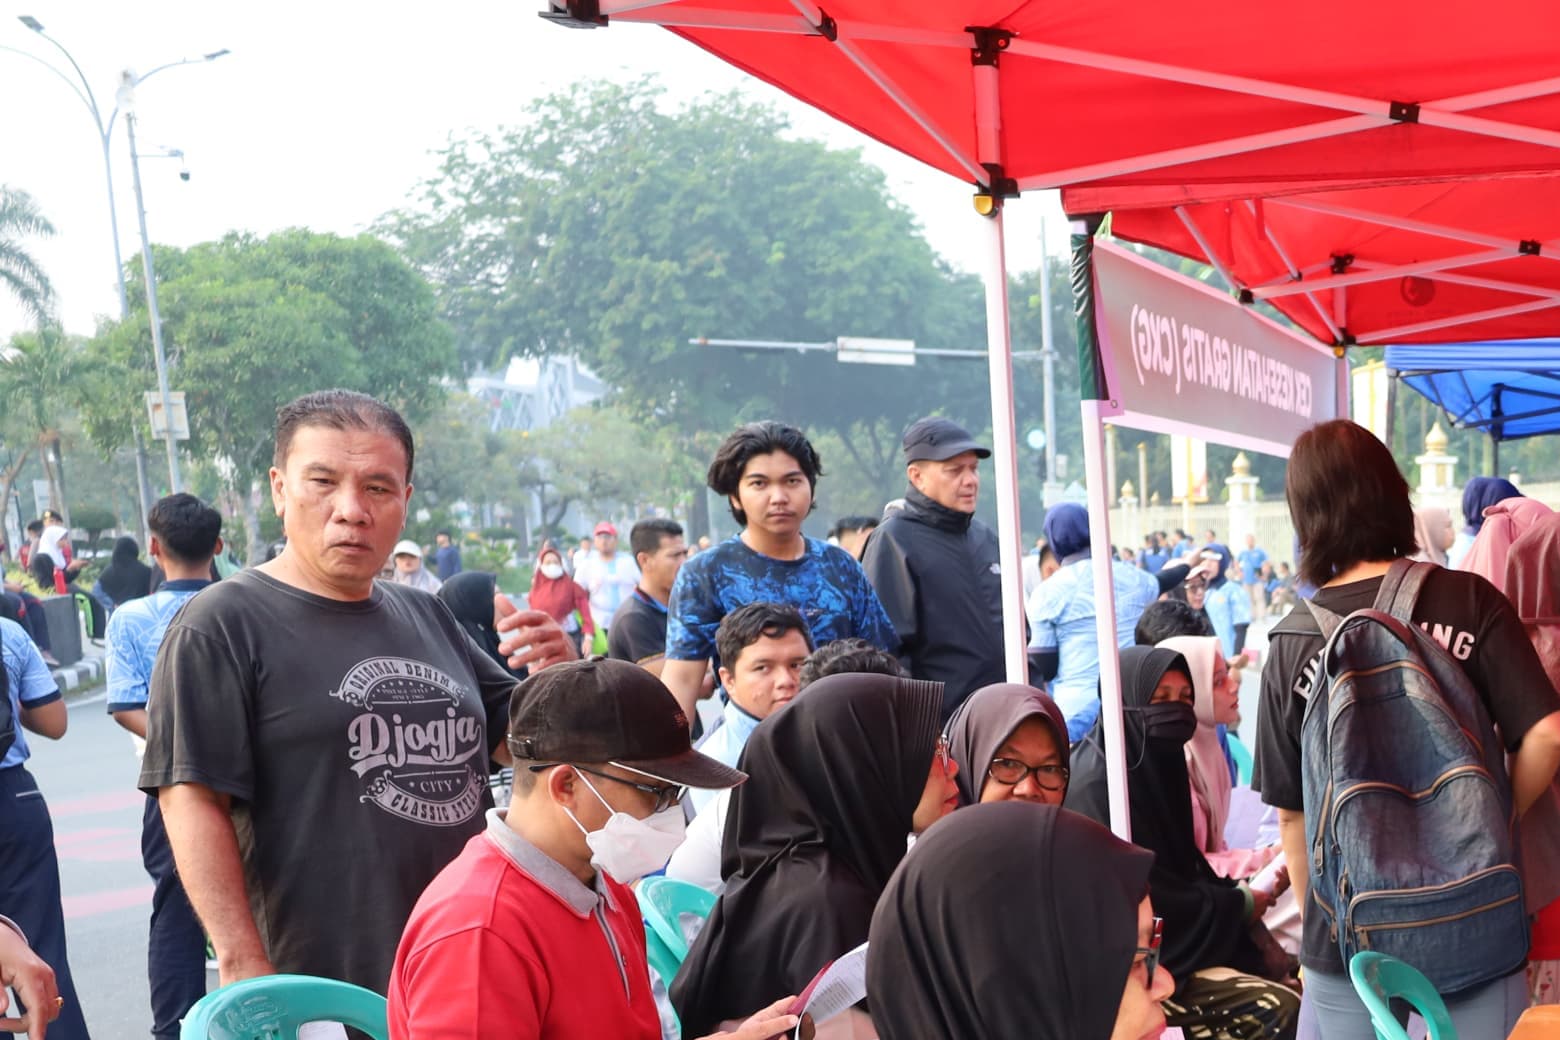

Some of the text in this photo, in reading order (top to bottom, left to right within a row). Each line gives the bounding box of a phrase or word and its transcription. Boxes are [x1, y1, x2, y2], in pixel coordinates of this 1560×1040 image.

[350, 661, 450, 690] ORIGINAL DENIM
[348, 707, 482, 768] Djogja
[420, 779, 453, 793] CITY
[391, 793, 450, 821] CLASSIC
